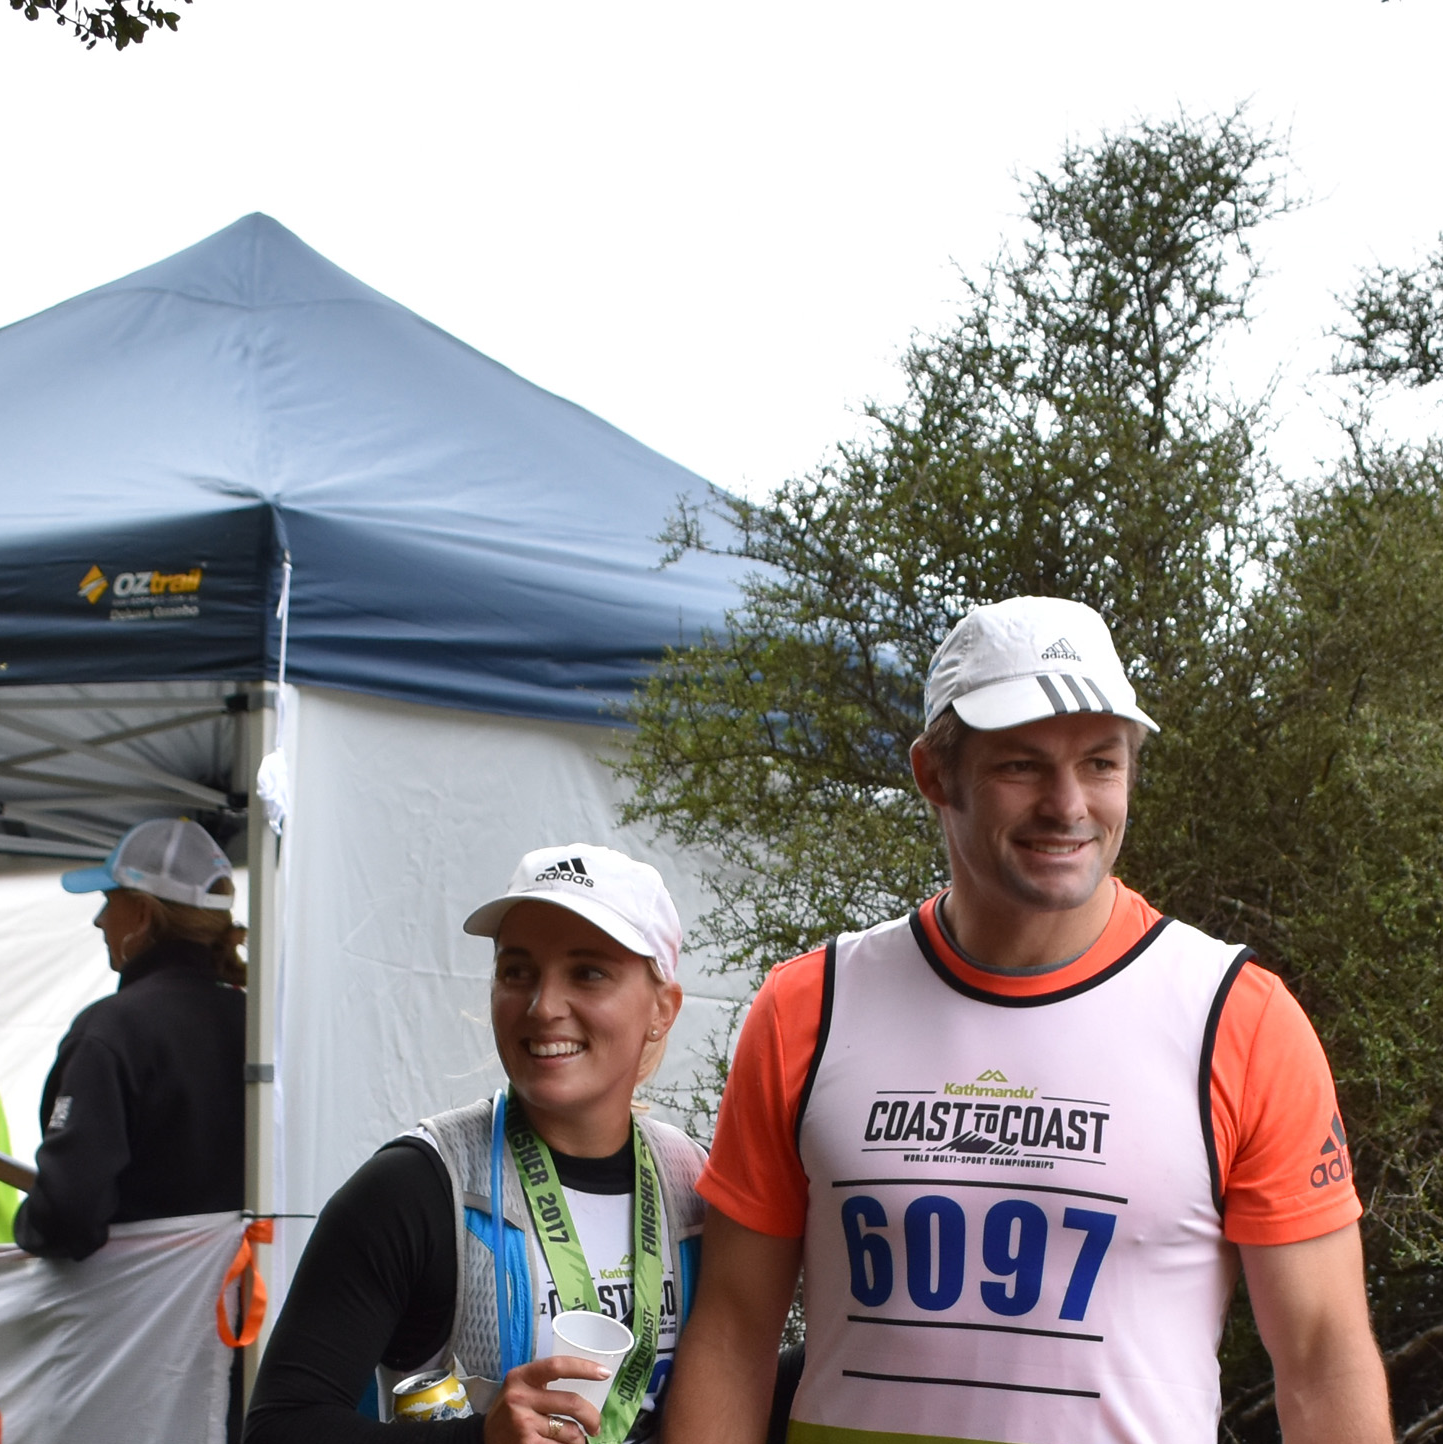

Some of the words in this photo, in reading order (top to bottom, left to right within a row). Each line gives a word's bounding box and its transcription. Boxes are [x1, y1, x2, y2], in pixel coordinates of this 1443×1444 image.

[113, 568, 203, 598] OZtrail
[1041, 651, 1082, 662] adidas
[535, 868, 595, 889] adidas
[943, 1082, 1036, 1099] Kathmandu
[864, 1100, 973, 1142] COAST
[973, 1112, 999, 1134] TO
[998, 1105, 1110, 1154] COAST
[903, 1153, 930, 1162] WORLD
[932, 1155, 987, 1165] MULTI-SPORT
[989, 1157, 1054, 1170] CHAMPIONSHIPS
[537, 1191, 570, 1244] 2017
[639, 1165, 657, 1257] FINISHER
[840, 1194, 1118, 1323] 6097
[617, 1358, 644, 1402] COAST
[641, 1309, 655, 1354] COAST
